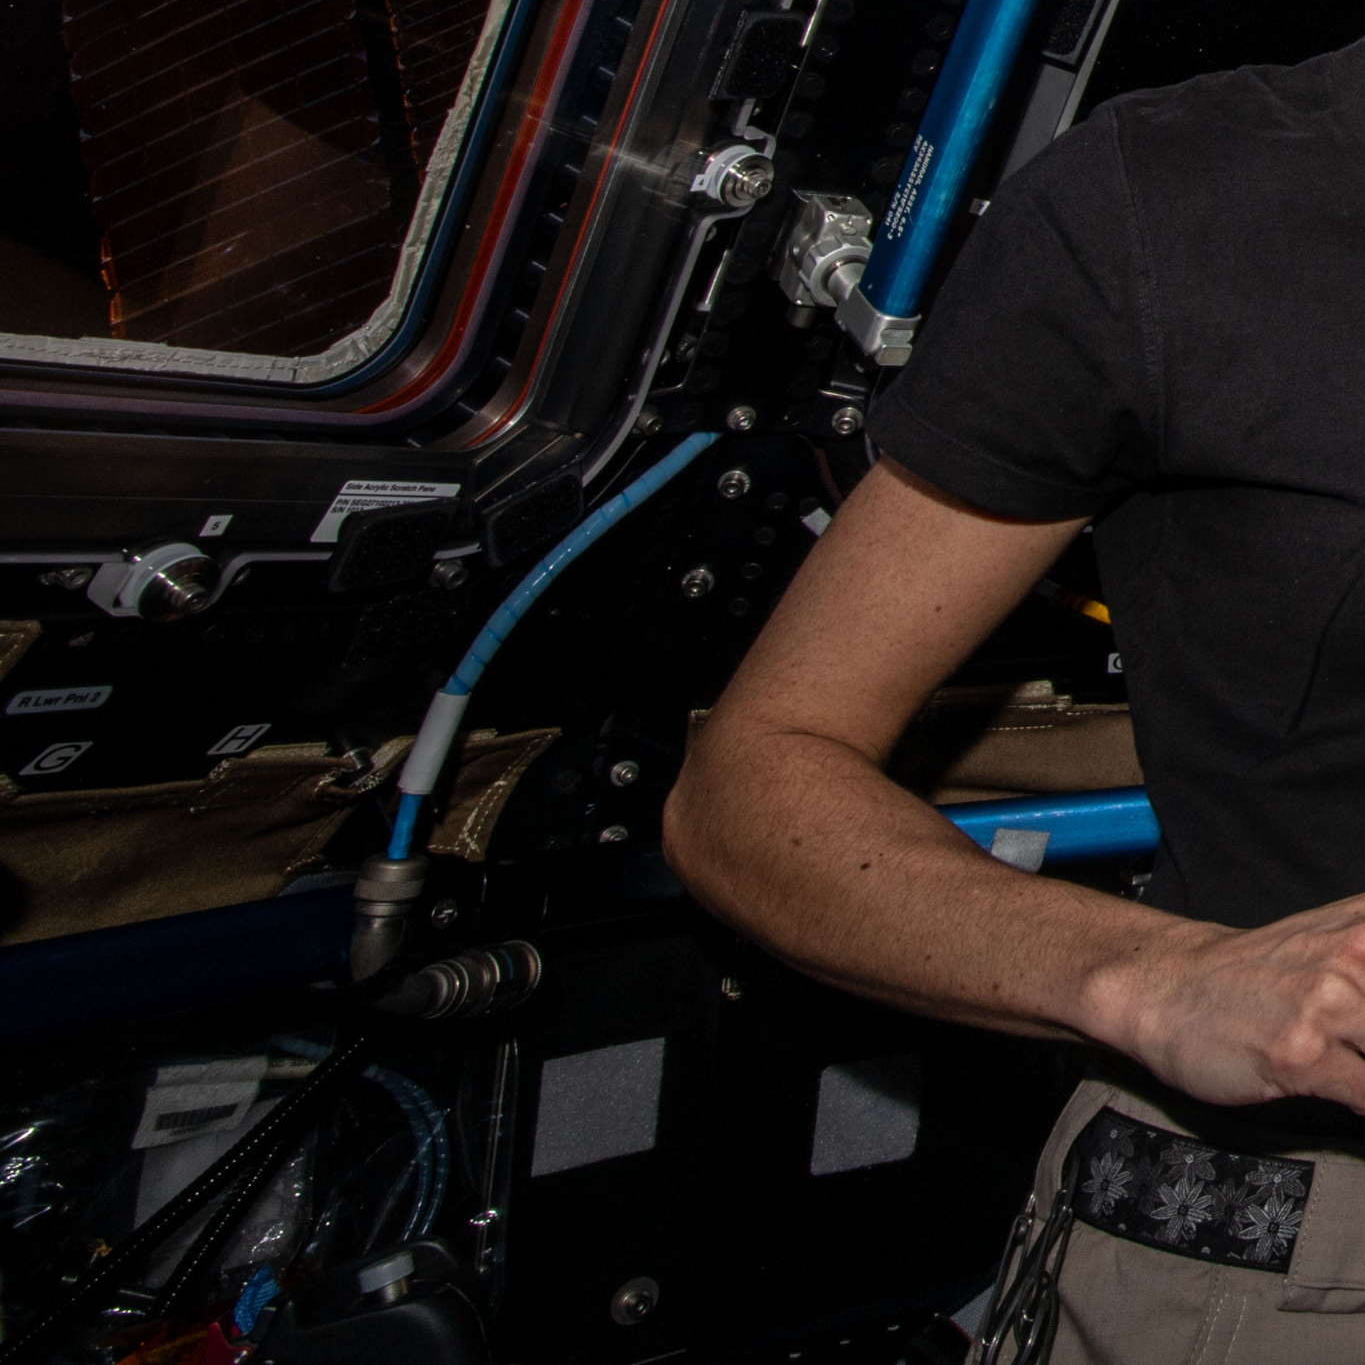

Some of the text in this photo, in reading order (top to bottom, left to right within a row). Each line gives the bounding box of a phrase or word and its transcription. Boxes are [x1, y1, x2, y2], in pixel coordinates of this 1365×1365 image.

[915, 144, 935, 186] HANDRAIL
[345, 483, 437, 494] Side Acrylic Scratch Pane
[211, 521, 222, 531] 5
[17, 692, 103, 708] R Lwr Pnl 2
[215, 725, 266, 752] H
[33, 744, 83, 772] G
